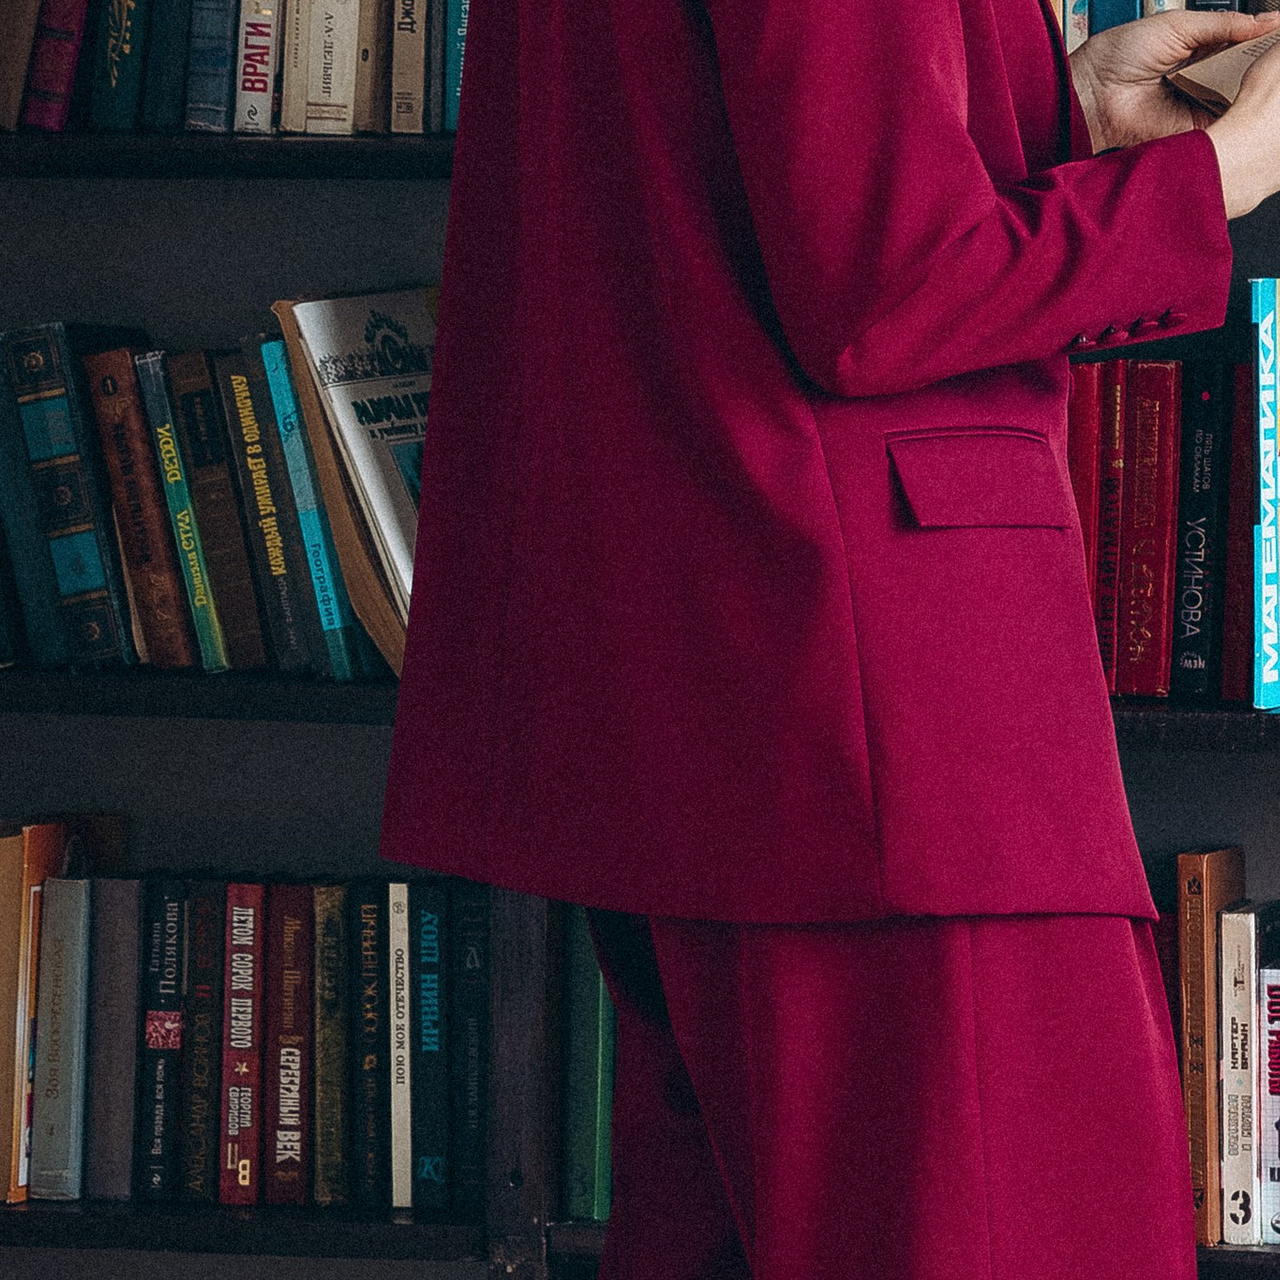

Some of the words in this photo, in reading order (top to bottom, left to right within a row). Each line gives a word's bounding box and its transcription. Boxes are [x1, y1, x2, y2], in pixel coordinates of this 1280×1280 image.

[241, 22, 271, 93] ВРАГИ
[230, 375, 261, 442] ОДИНОЧКУ
[246, 457, 278, 514] УМИРАЕТ
[1259, 309, 1280, 684] МАТЕМАТИКА
[259, 516, 287, 576] КАЖДЫЙ
[1180, 516, 1208, 640] УСТИНОВА
[159, 902, 179, 995] Полякова
[231, 907, 254, 946] ЛЕТОМ
[421, 909, 440, 963] ШОУ
[231, 953, 254, 990] СОРОК
[394, 948, 406, 1019] ОТЕЧЕСТВО
[230, 997, 252, 1048] ПЕРВОГО
[395, 1023, 406, 1050] МОЕ
[421, 973, 441, 1052] ИРВИН
[395, 1055, 406, 1084] ПОЮ
[1229, 1015, 1240, 1070] КАРТЕР
[1240, 1023, 1250, 1070] БРАУН
